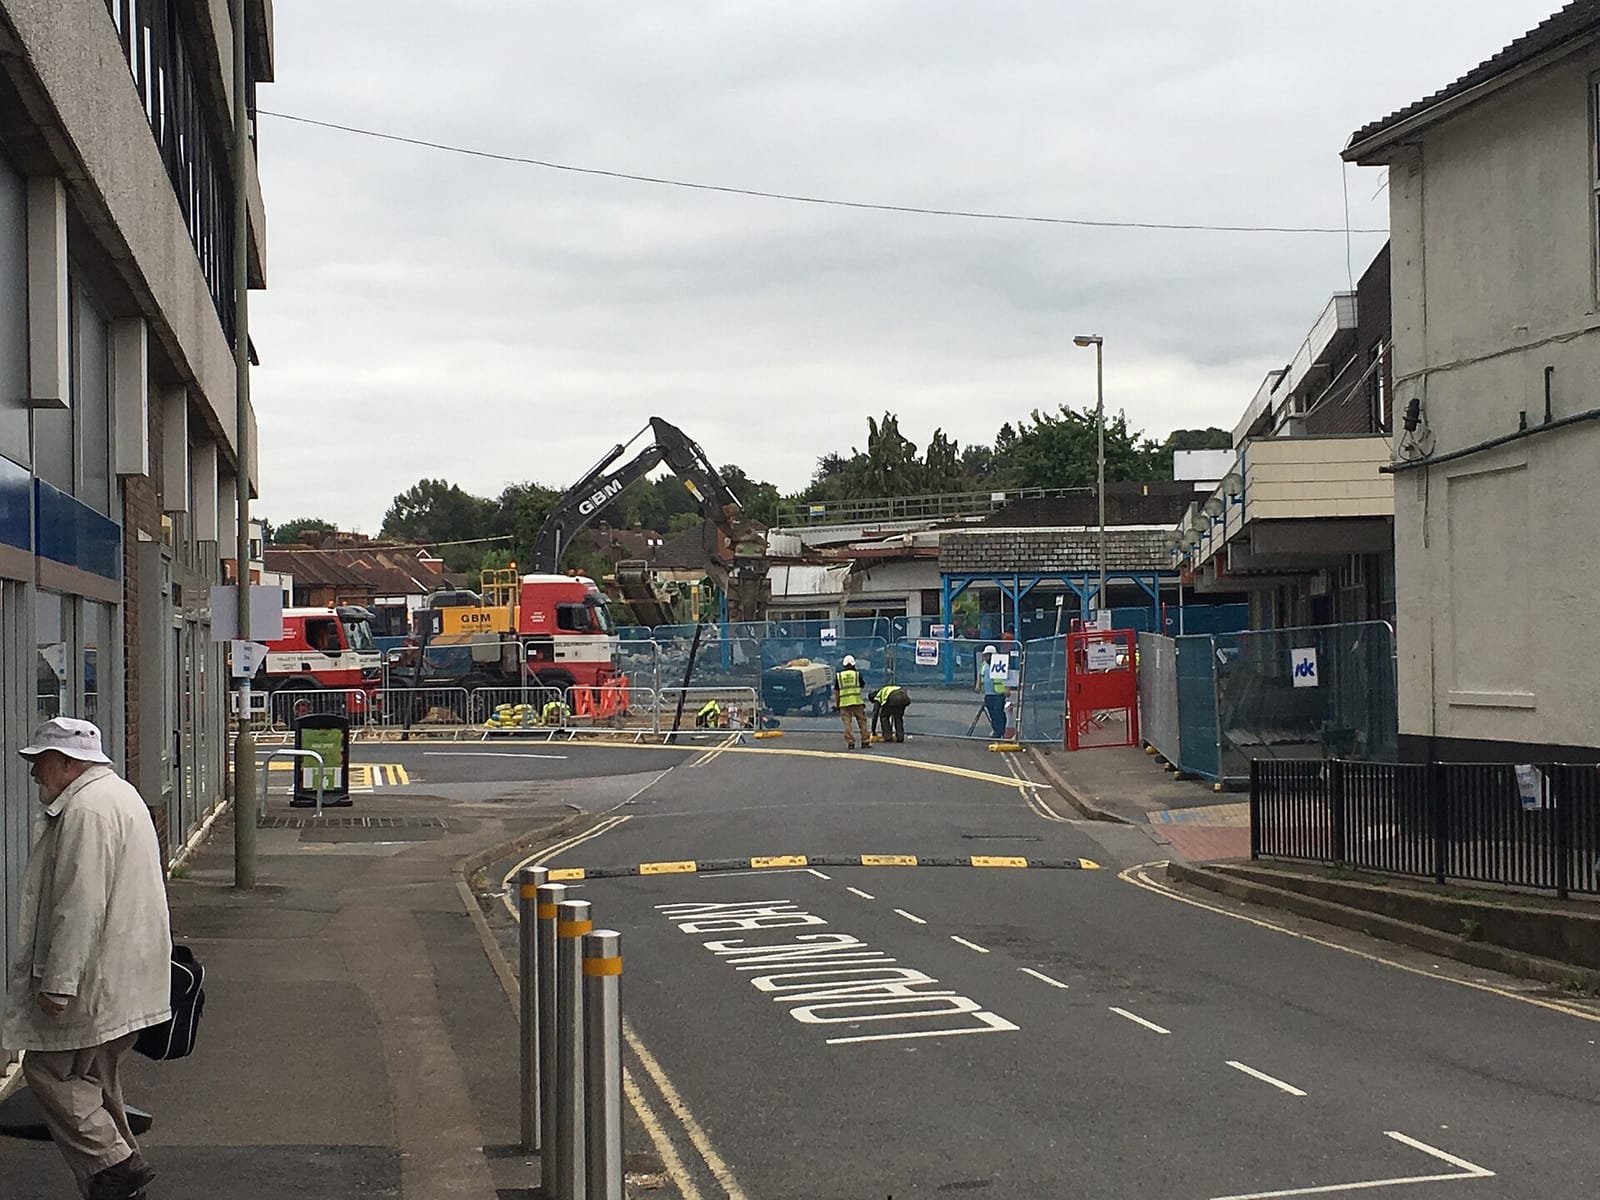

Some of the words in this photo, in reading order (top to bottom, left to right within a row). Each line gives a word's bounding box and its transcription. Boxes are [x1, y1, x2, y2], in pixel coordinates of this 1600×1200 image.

[578, 478, 623, 515] GBM
[460, 613, 492, 623] GBM
[654, 900, 828, 934] BAY
[703, 932, 1020, 1044] LOADING
